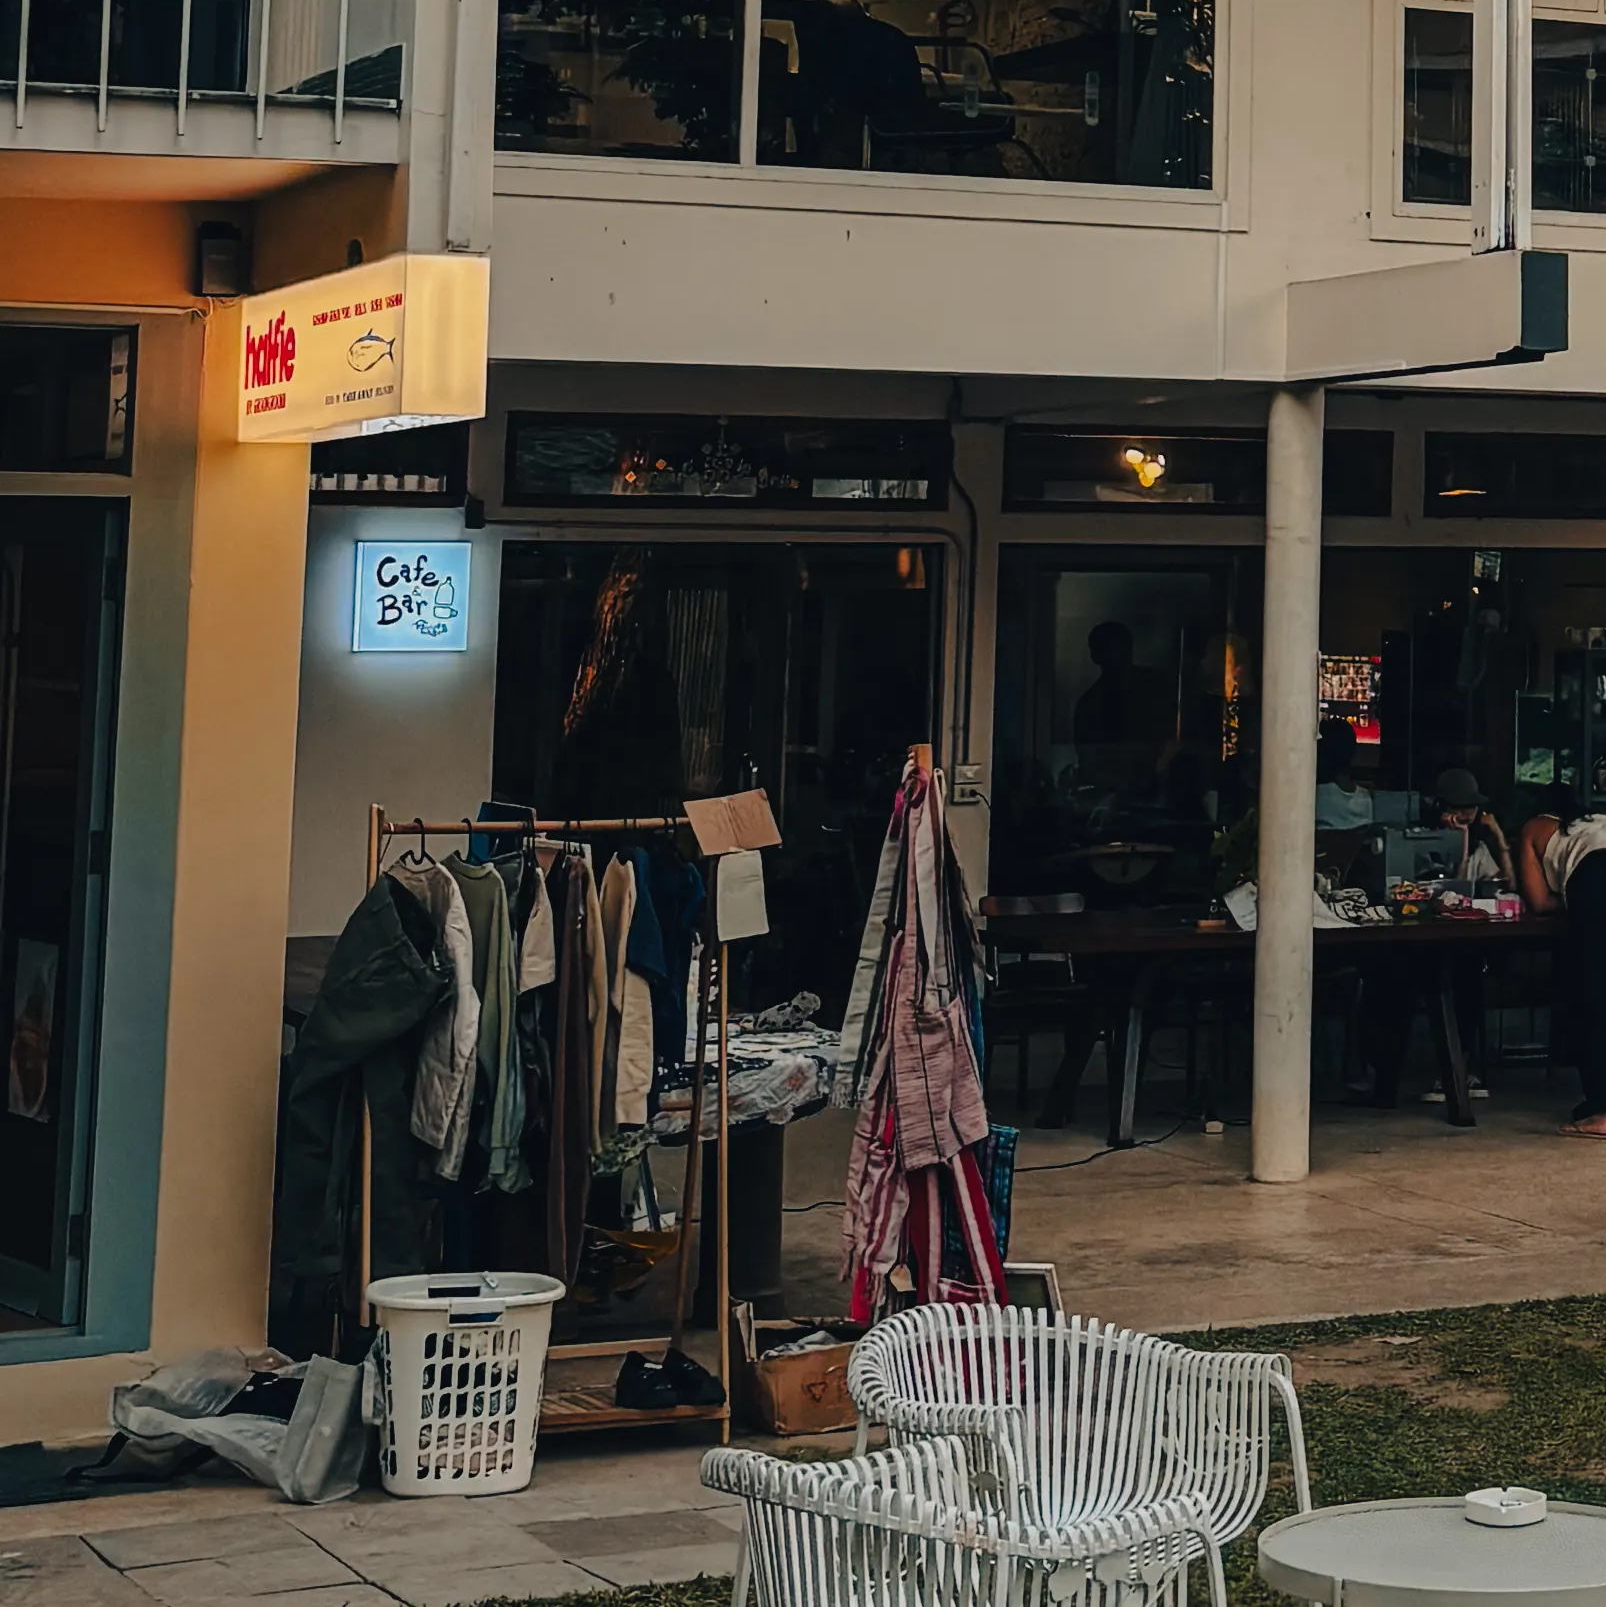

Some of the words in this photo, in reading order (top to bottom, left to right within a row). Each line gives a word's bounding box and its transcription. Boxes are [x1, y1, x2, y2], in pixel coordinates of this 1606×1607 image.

[244, 309, 296, 390] halfie
[376, 554, 440, 588] Cafe
[376, 593, 429, 626] Bar
